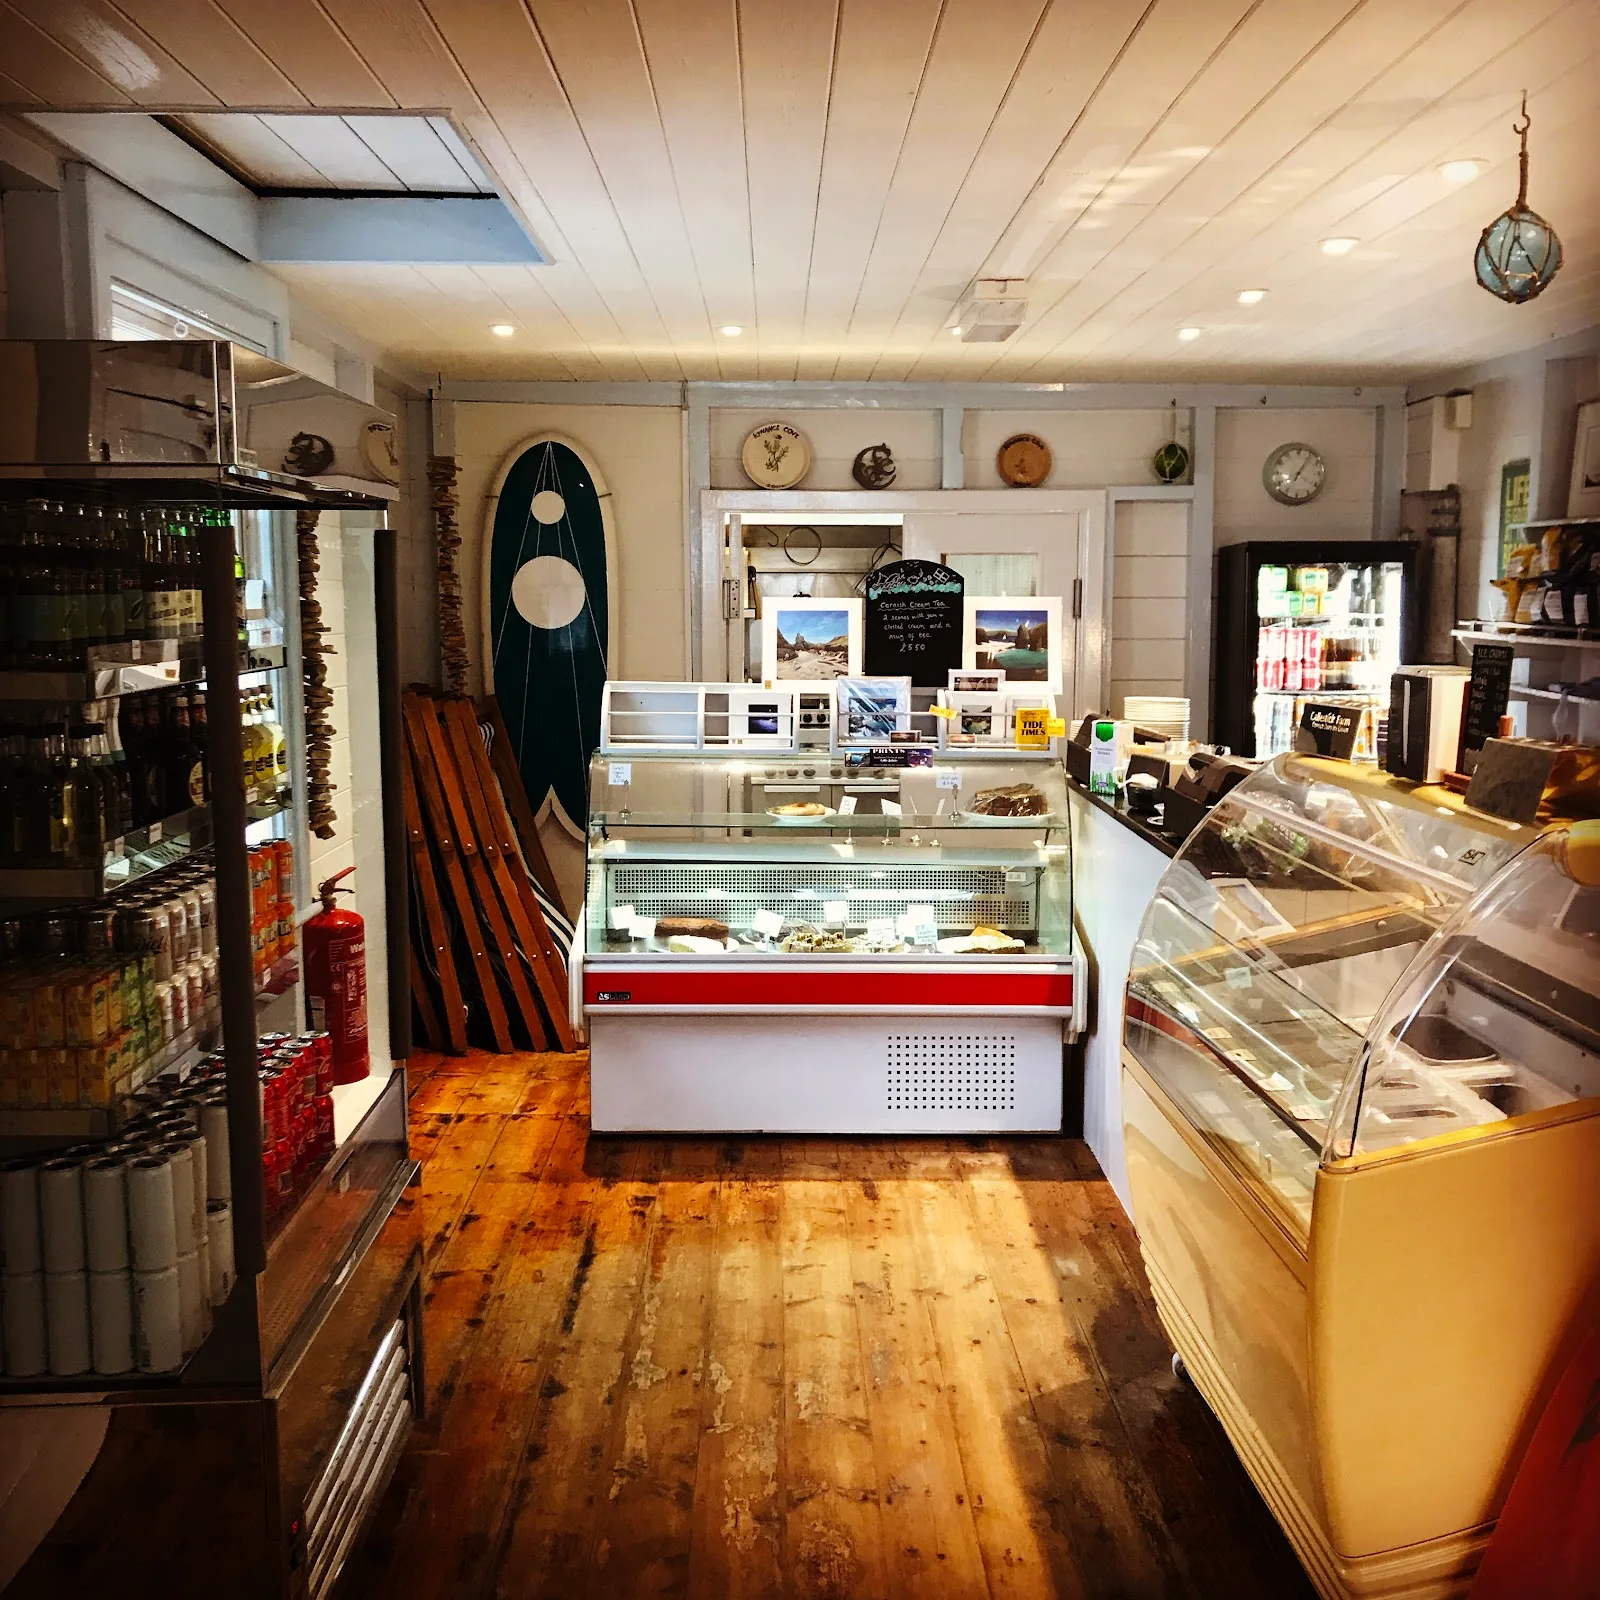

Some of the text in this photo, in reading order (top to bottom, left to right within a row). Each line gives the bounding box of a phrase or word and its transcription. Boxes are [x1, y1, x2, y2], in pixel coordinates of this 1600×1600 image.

[783, 426, 800, 439] COVE
[880, 601, 907, 609] Cornish
[933, 599, 946, 607] Tea
[1022, 720, 1045, 729] TIDE
[1336, 714, 1351, 726] Farm
